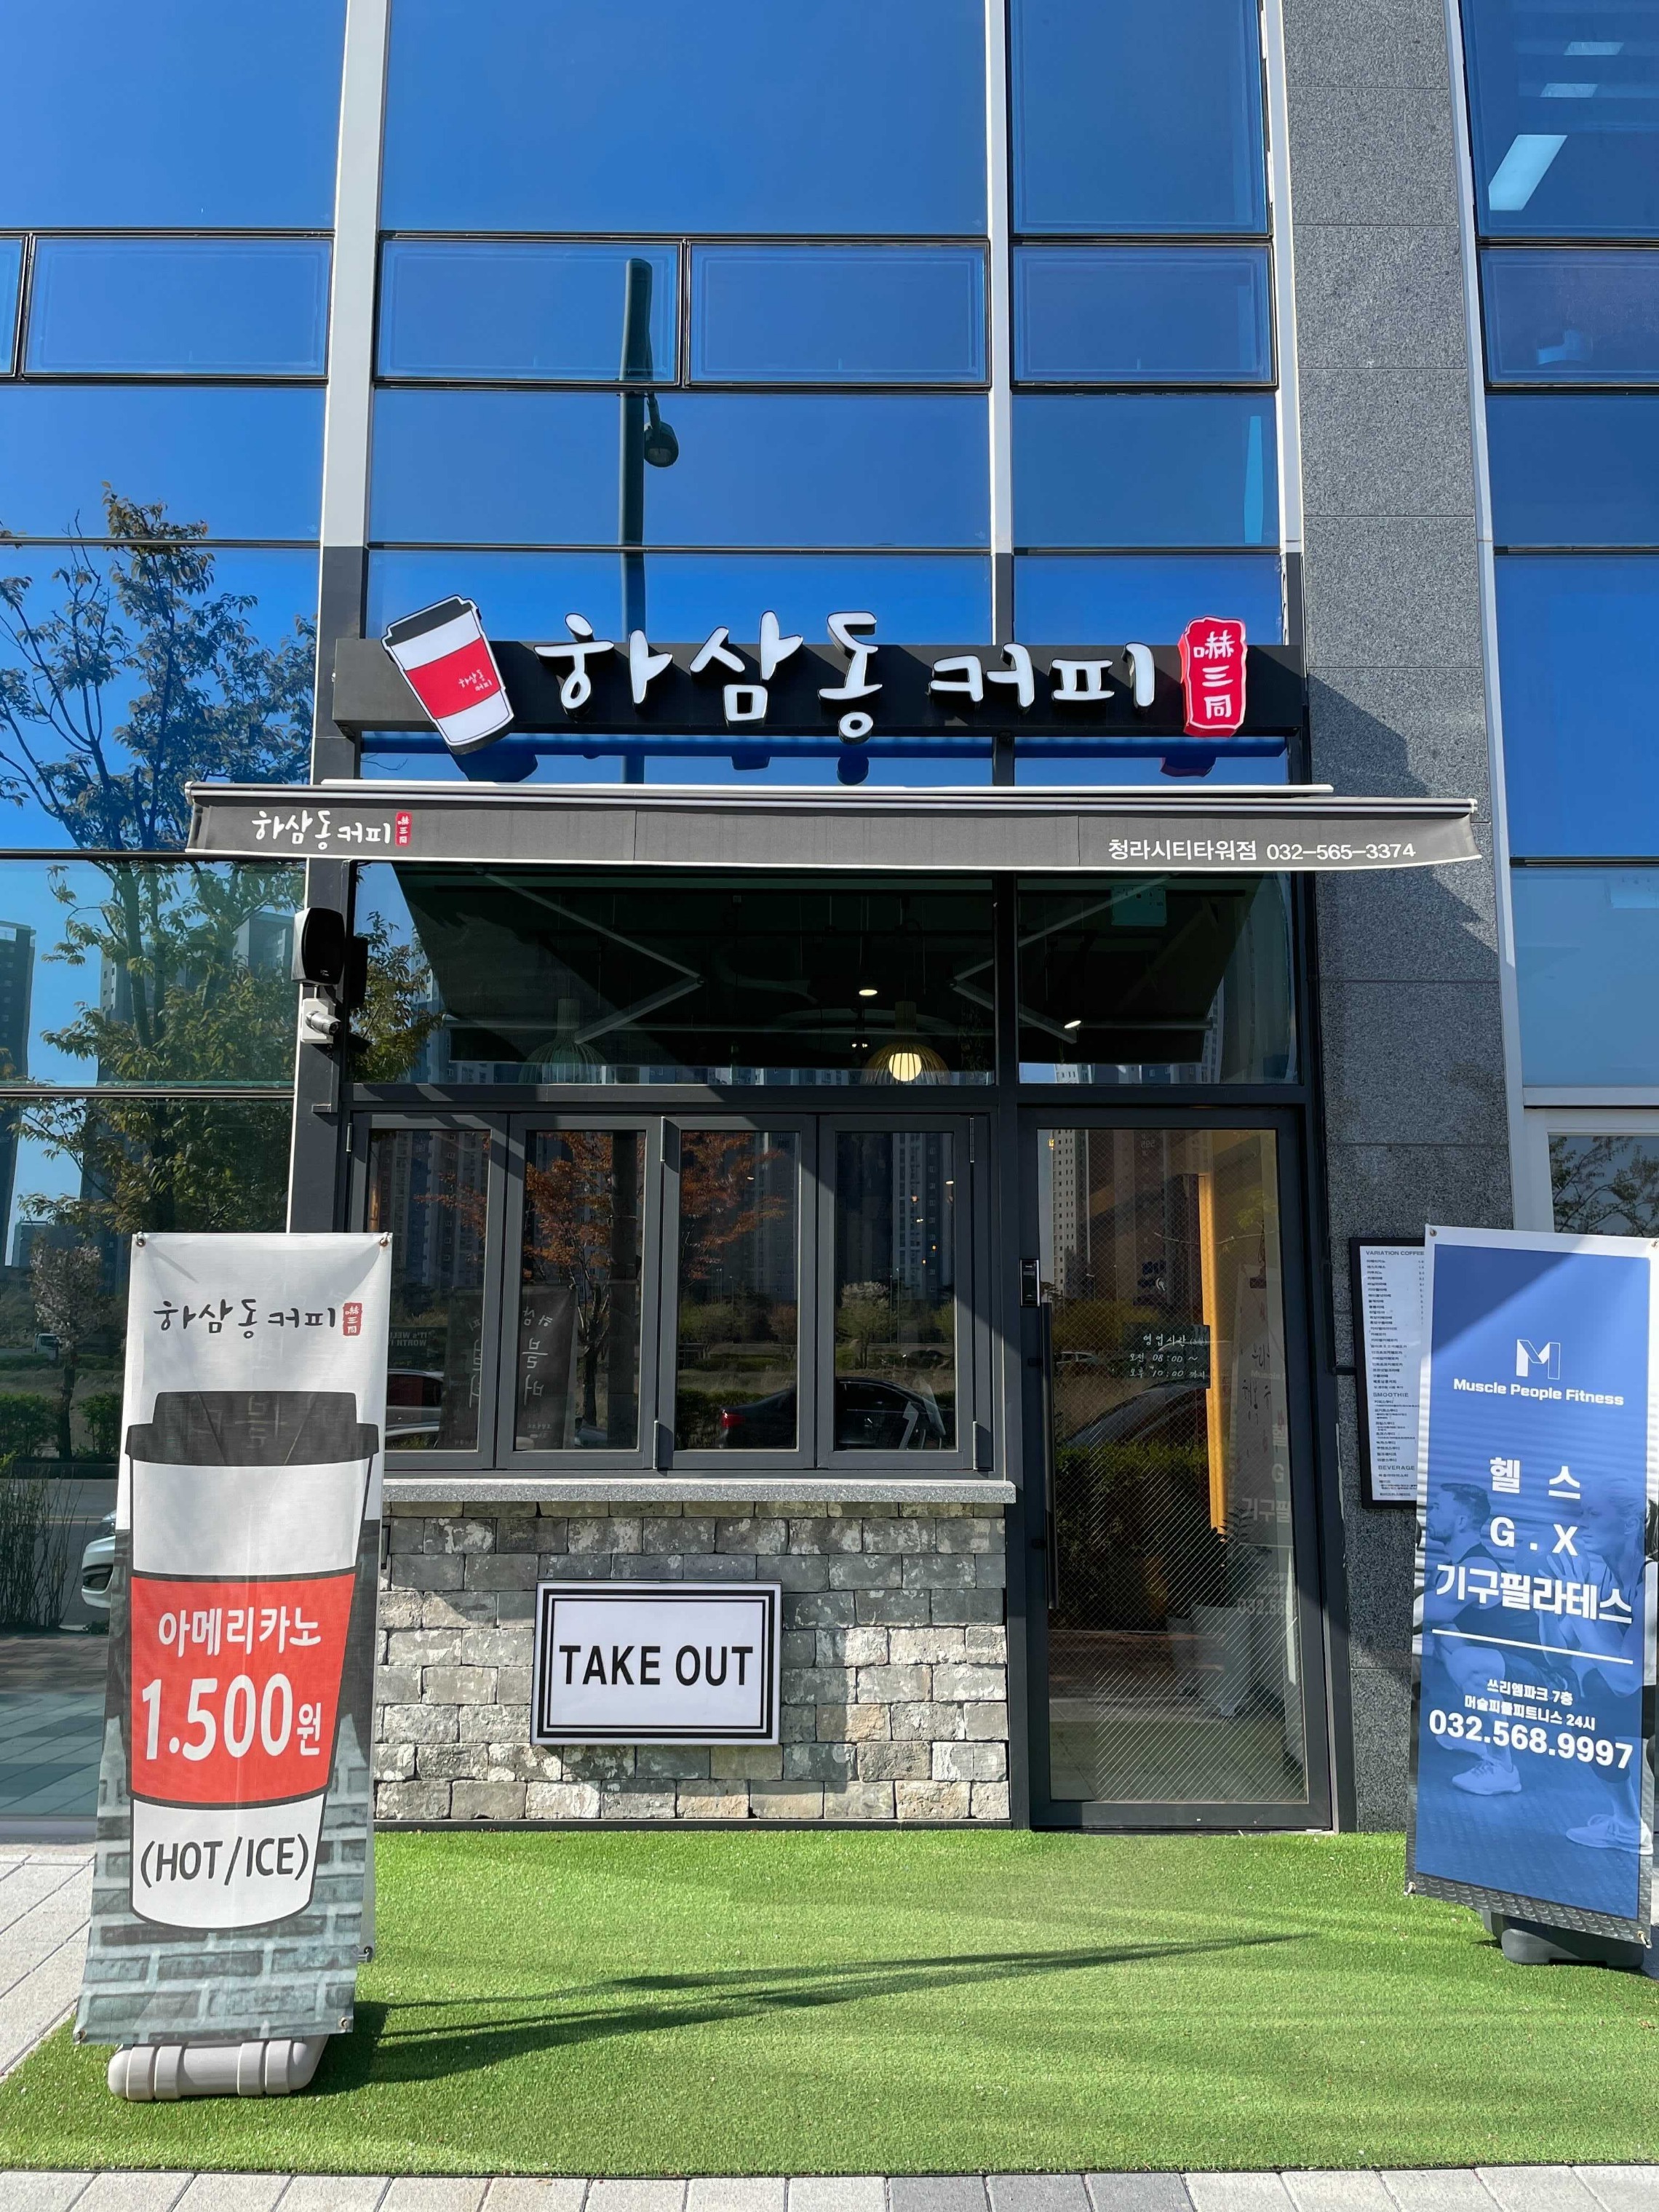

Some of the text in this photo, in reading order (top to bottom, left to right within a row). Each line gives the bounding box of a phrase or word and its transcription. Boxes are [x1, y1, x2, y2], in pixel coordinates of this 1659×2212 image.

[534, 611, 1154, 744] 하삼동 커피
[252, 809, 391, 850] 하삼동 커피
[1107, 839, 1417, 861] 청라시티타워점 032-565-3374
[153, 1299, 335, 1339] 하삼동 커피
[1143, 1333, 1187, 1347] 영업시간
[1453, 1378, 1625, 1406] Muscle People Fitness
[1436, 1564, 1633, 1624] 기구필라테스
[158, 1605, 322, 1658] 아메리카노
[559, 1644, 754, 1686] TAKE OUT
[1487, 1678, 1573, 1706] 쓰리엠파크 7층
[1464, 1695, 1596, 1731] 머슬피플피트니스 24시
[1428, 1709, 1634, 1770] 032.568.9997
[140, 1833, 310, 1889] (HOT/ICE)
